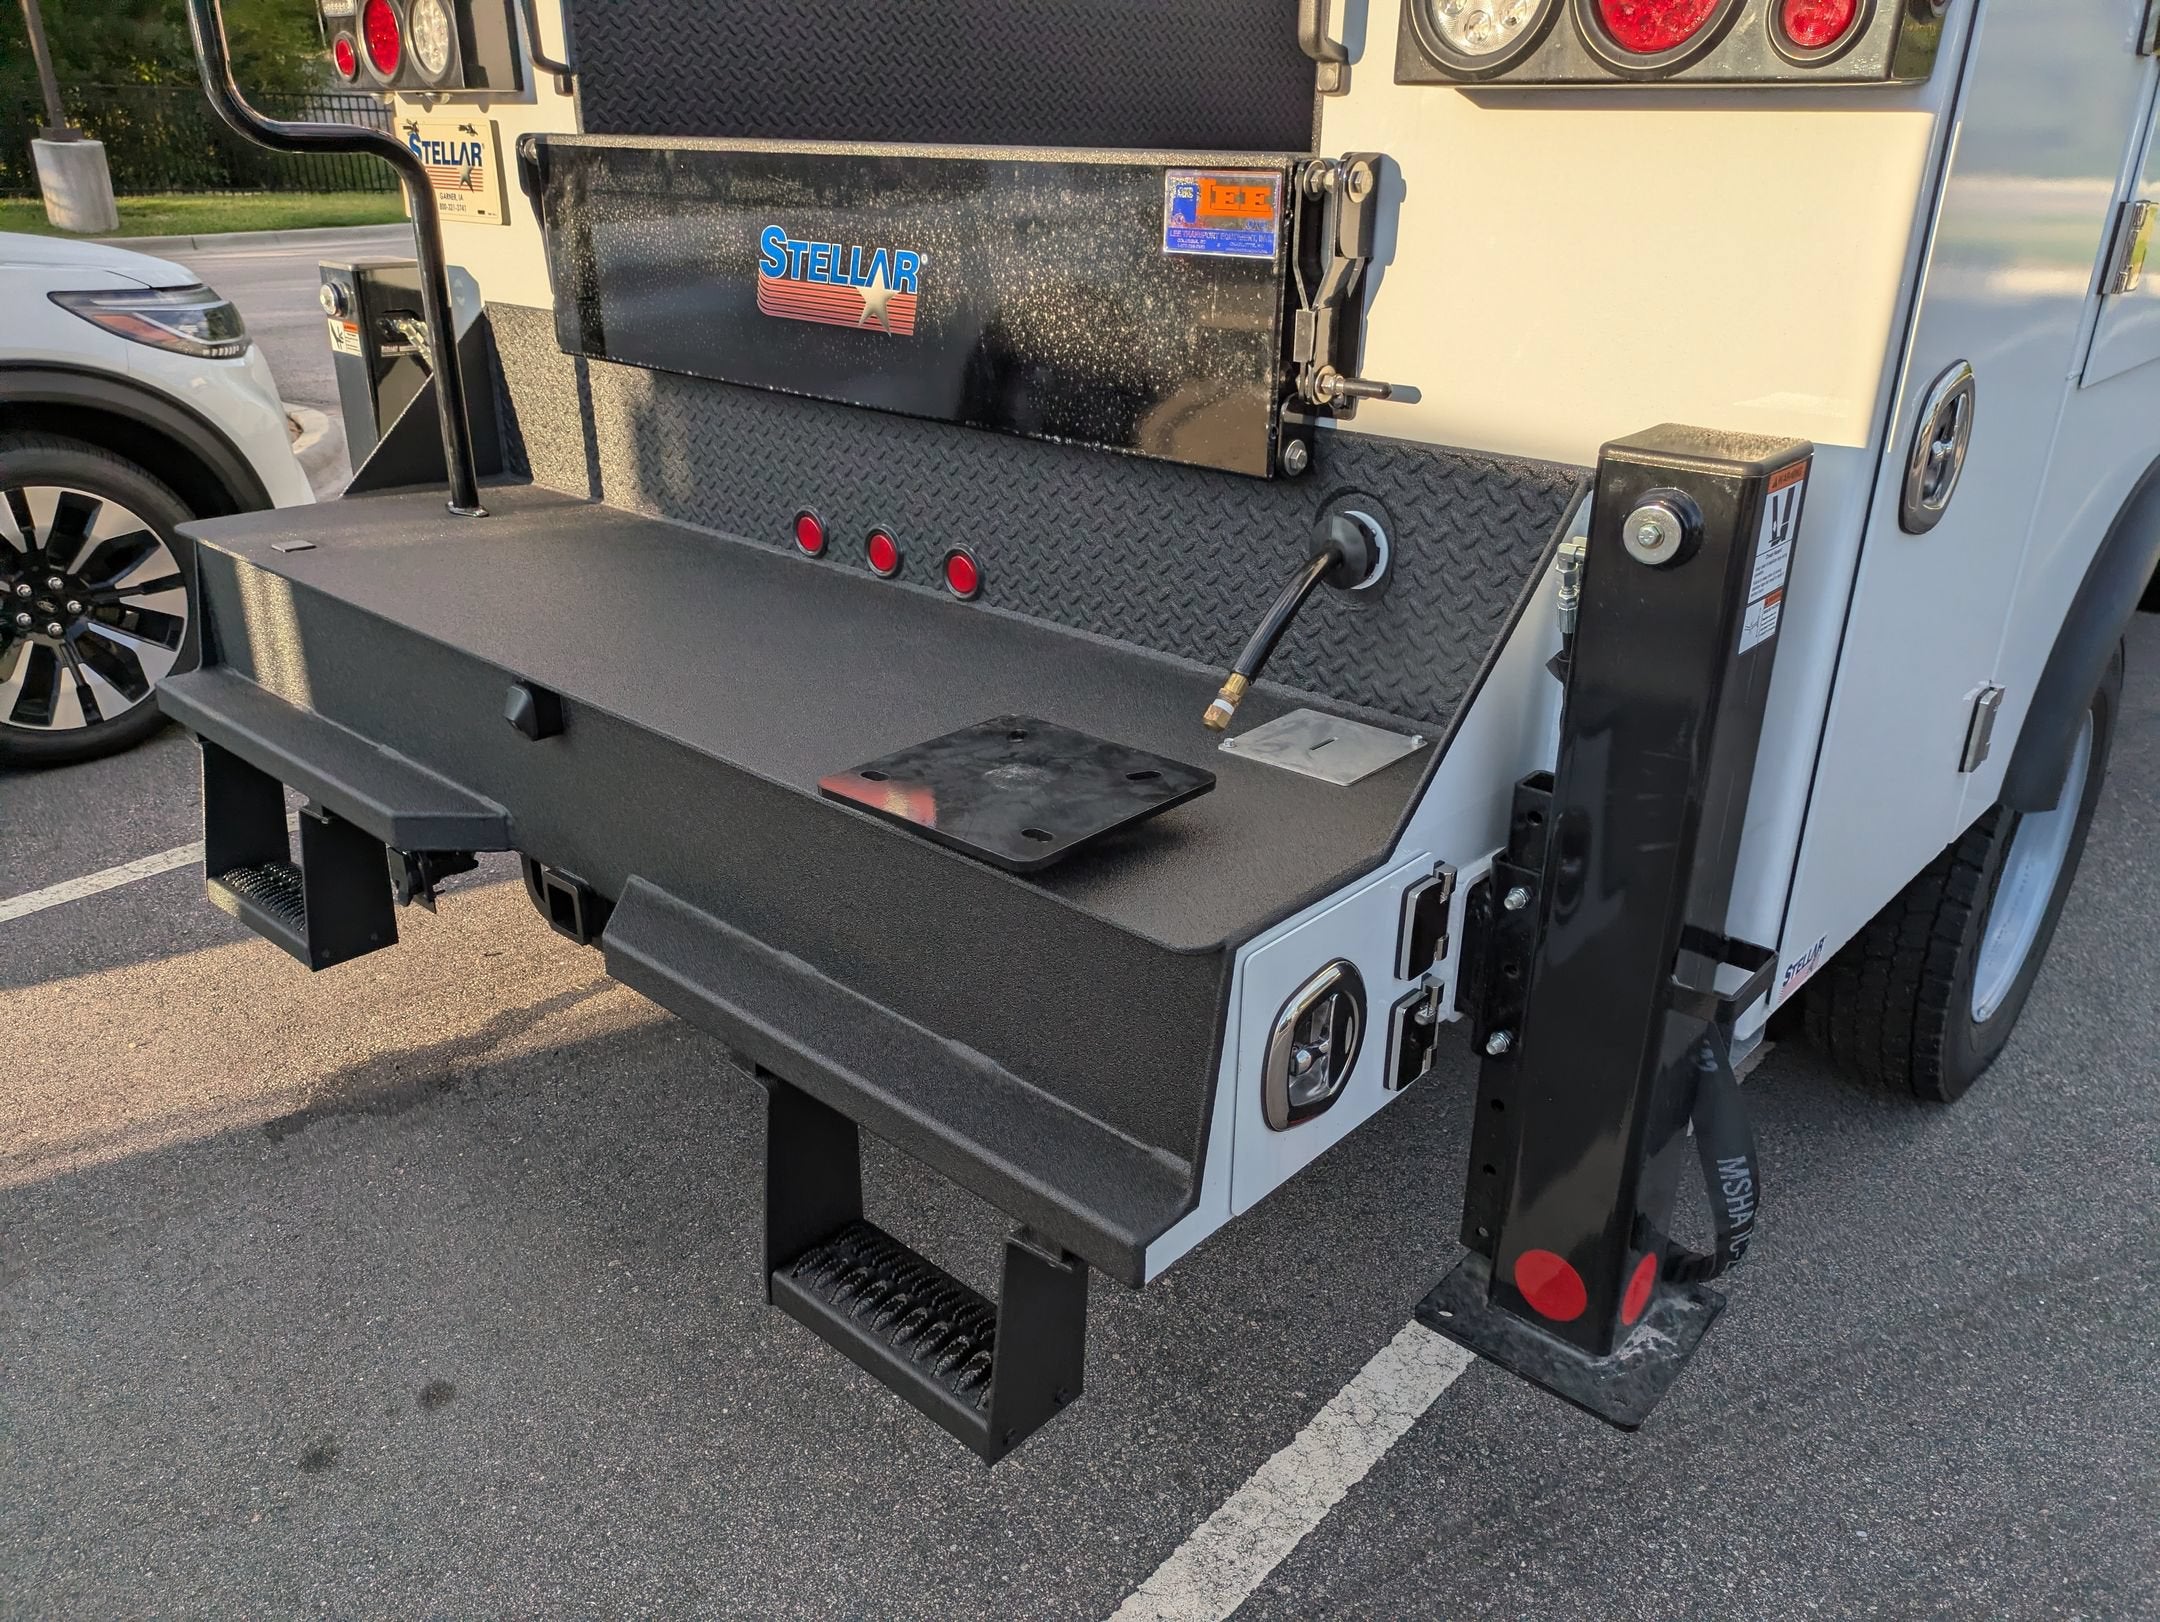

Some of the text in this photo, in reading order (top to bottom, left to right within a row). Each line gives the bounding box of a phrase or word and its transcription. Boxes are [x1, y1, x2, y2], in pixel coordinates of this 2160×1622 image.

[409, 131, 482, 167] STELLAR
[1196, 177, 1273, 220] LEE
[759, 225, 921, 295] STELLAR
[1783, 936, 1825, 987] STELLAR
[1717, 1156, 1754, 1229] MSHA
